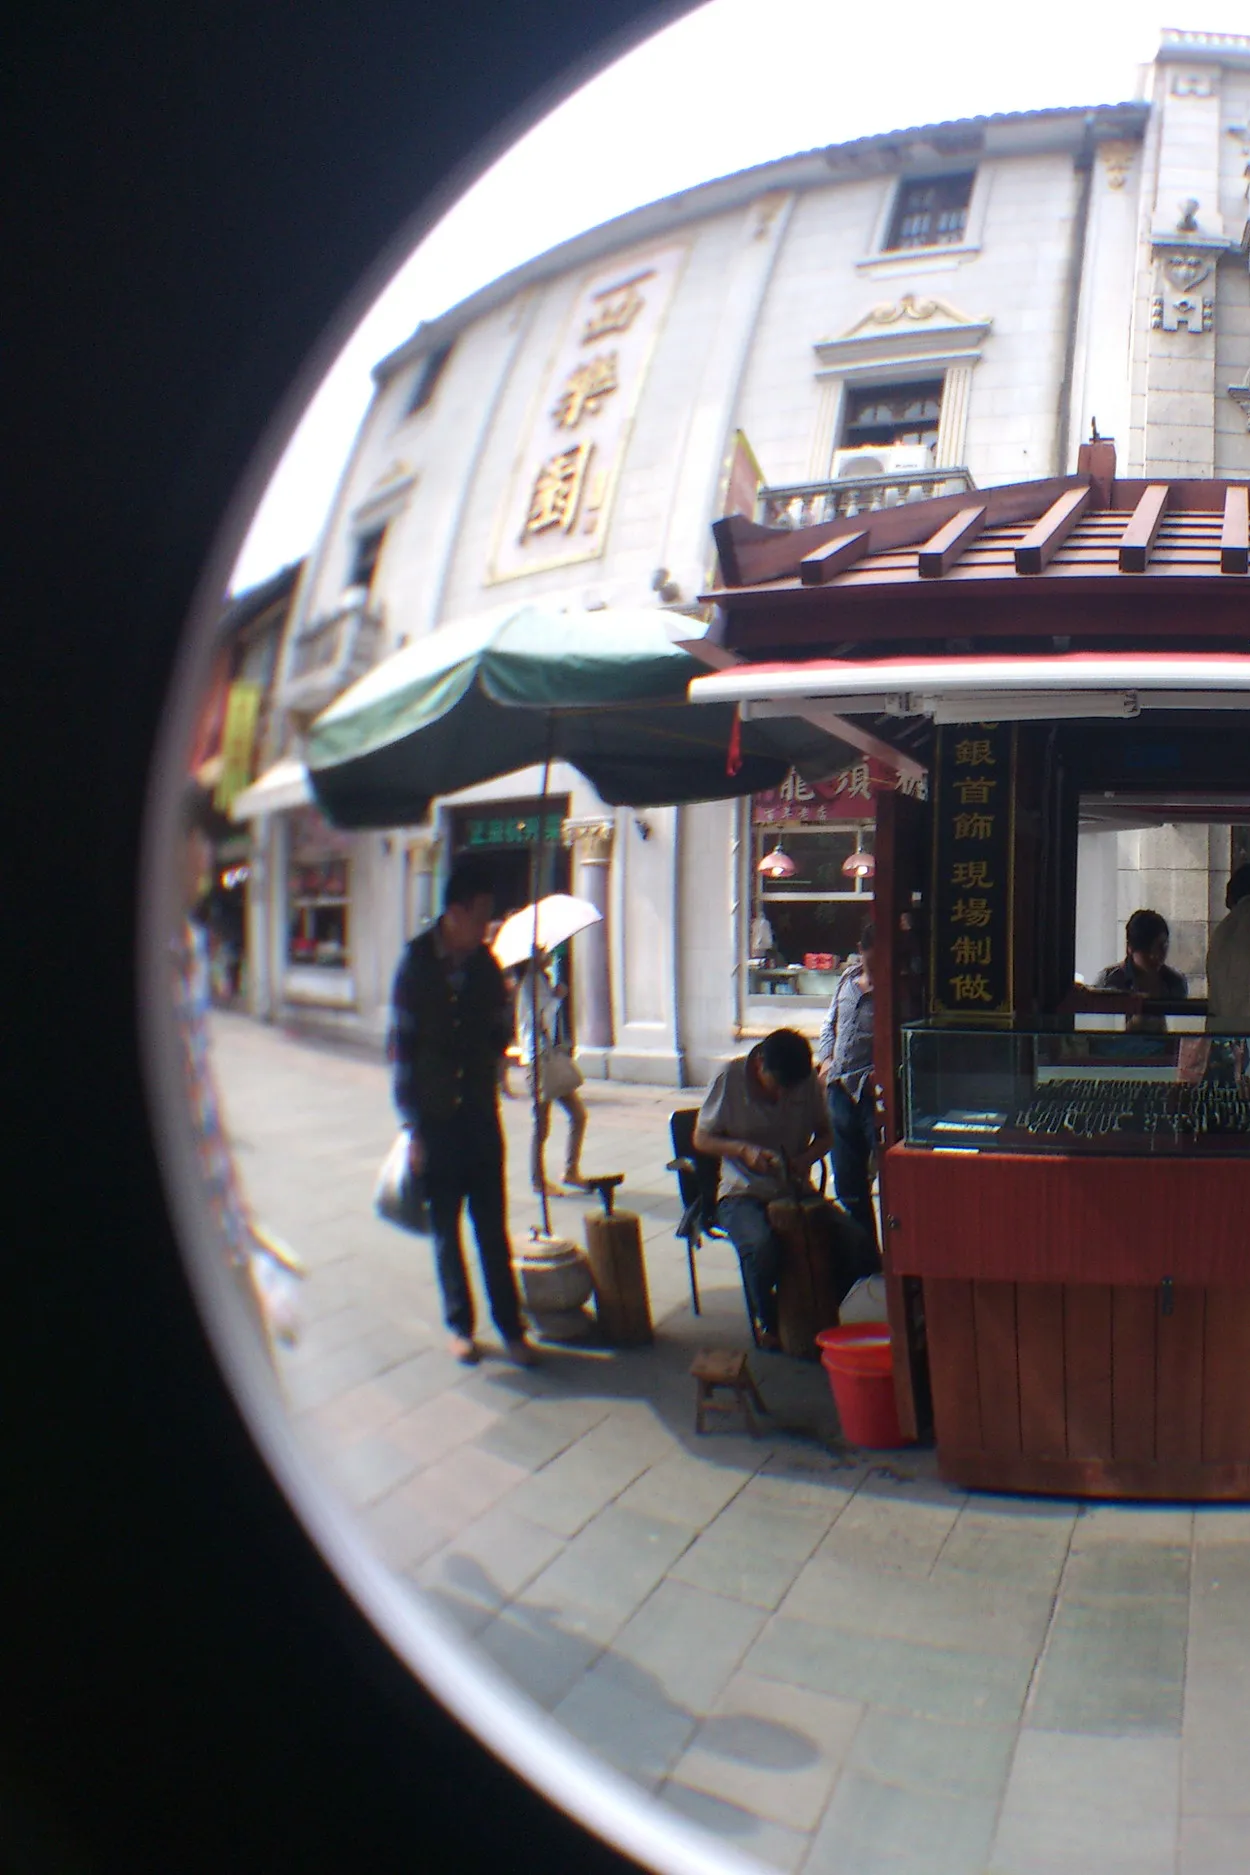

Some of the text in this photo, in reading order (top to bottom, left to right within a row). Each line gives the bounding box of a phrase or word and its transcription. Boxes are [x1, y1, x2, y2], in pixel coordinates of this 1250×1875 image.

[950, 722, 998, 1003] 銀首飾 現場制做
